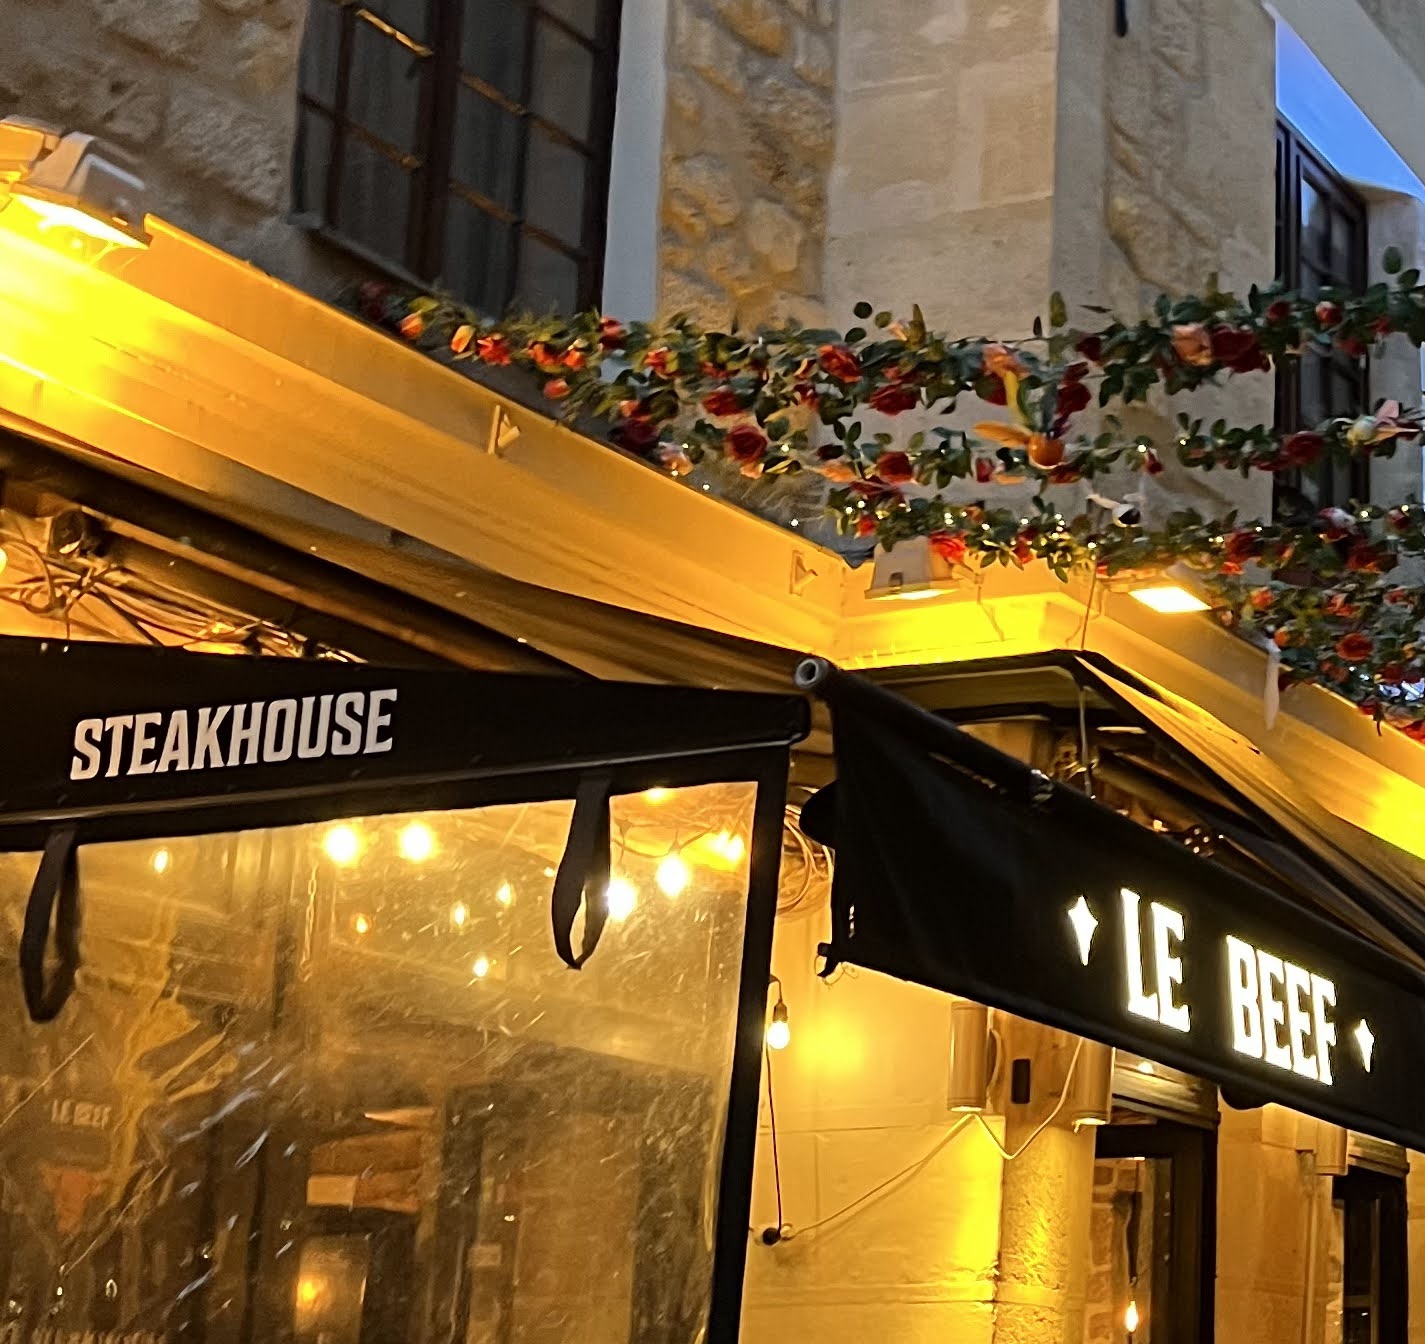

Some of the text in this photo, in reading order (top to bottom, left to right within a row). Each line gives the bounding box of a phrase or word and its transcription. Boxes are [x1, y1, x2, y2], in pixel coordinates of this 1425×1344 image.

[70, 688, 398, 781] STEAKHOUSE
[1119, 887, 1337, 1086] LE BEEF
